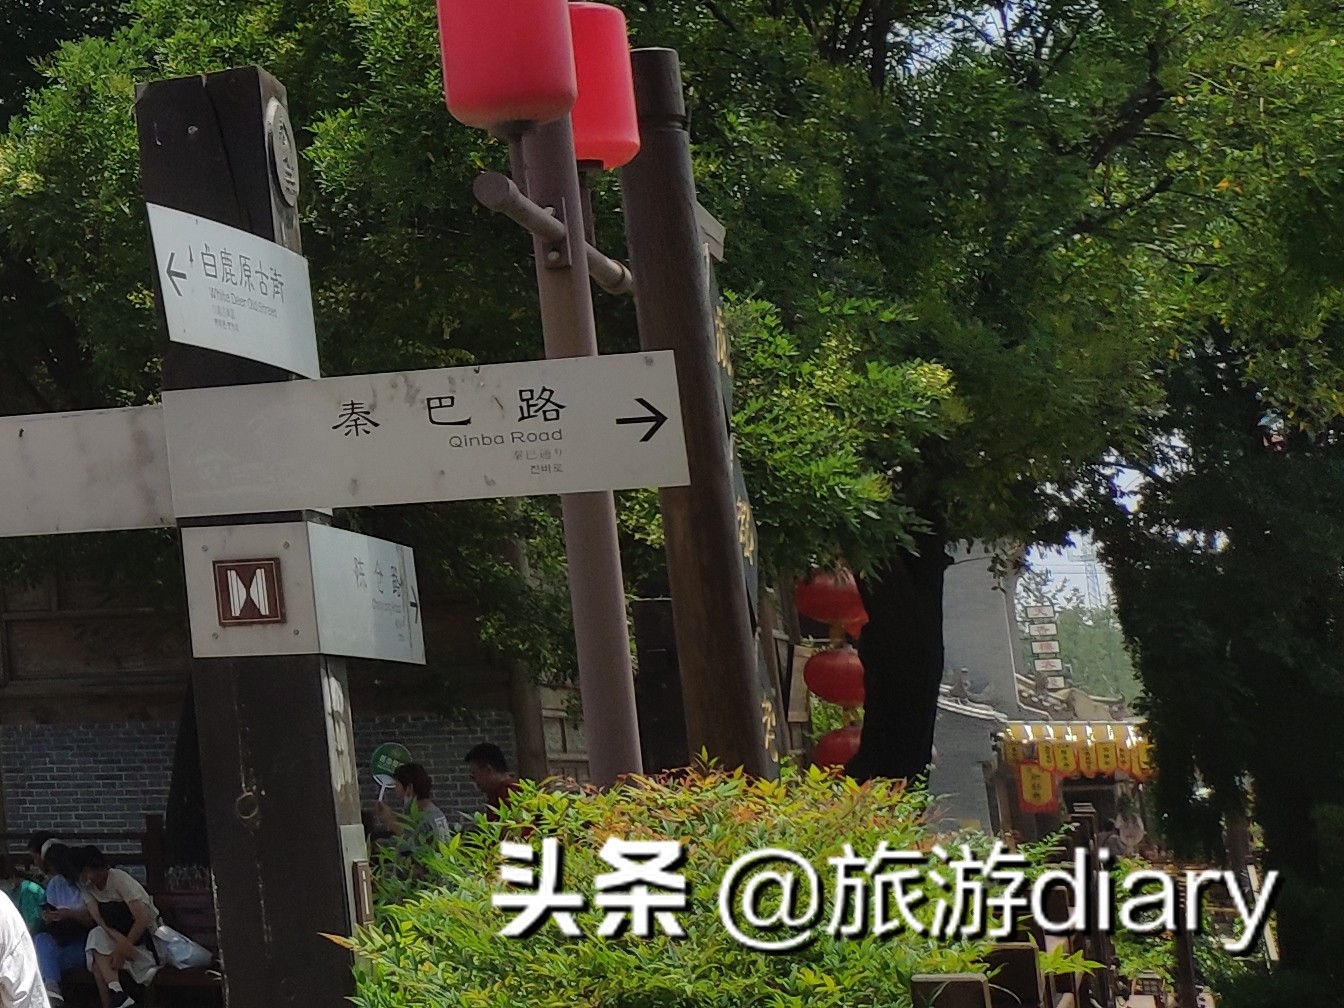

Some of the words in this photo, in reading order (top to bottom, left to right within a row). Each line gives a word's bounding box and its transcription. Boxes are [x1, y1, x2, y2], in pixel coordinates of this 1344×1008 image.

[201, 243, 285, 303] 白鹿原古街
[208, 286, 231, 304] White
[331, 385, 567, 438] 秦巴路
[448, 433, 506, 448] Qinba
[510, 428, 563, 444] Road
